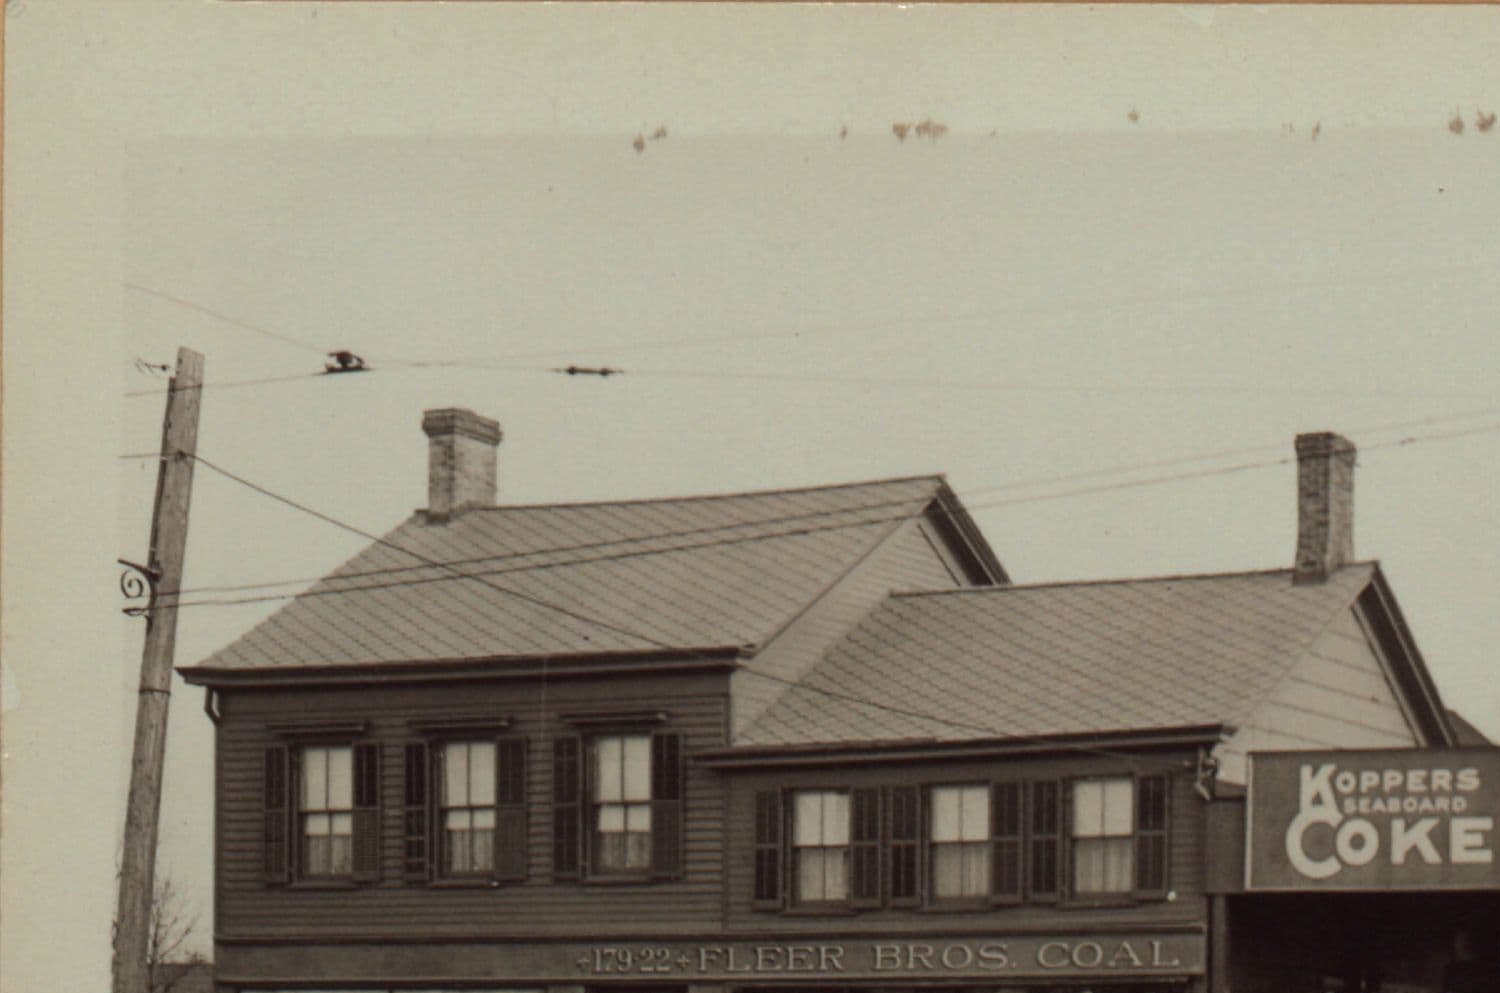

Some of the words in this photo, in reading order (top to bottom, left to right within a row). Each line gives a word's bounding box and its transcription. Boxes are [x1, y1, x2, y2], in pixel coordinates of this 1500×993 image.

[1300, 763, 1480, 817] KOPPERS
[1343, 796, 1467, 815] SEABOARD
[1285, 813, 1494, 879] COKE
[699, 946, 845, 972] FLEER
[873, 943, 1016, 970] BROS.
[1037, 941, 1180, 968] COAL
